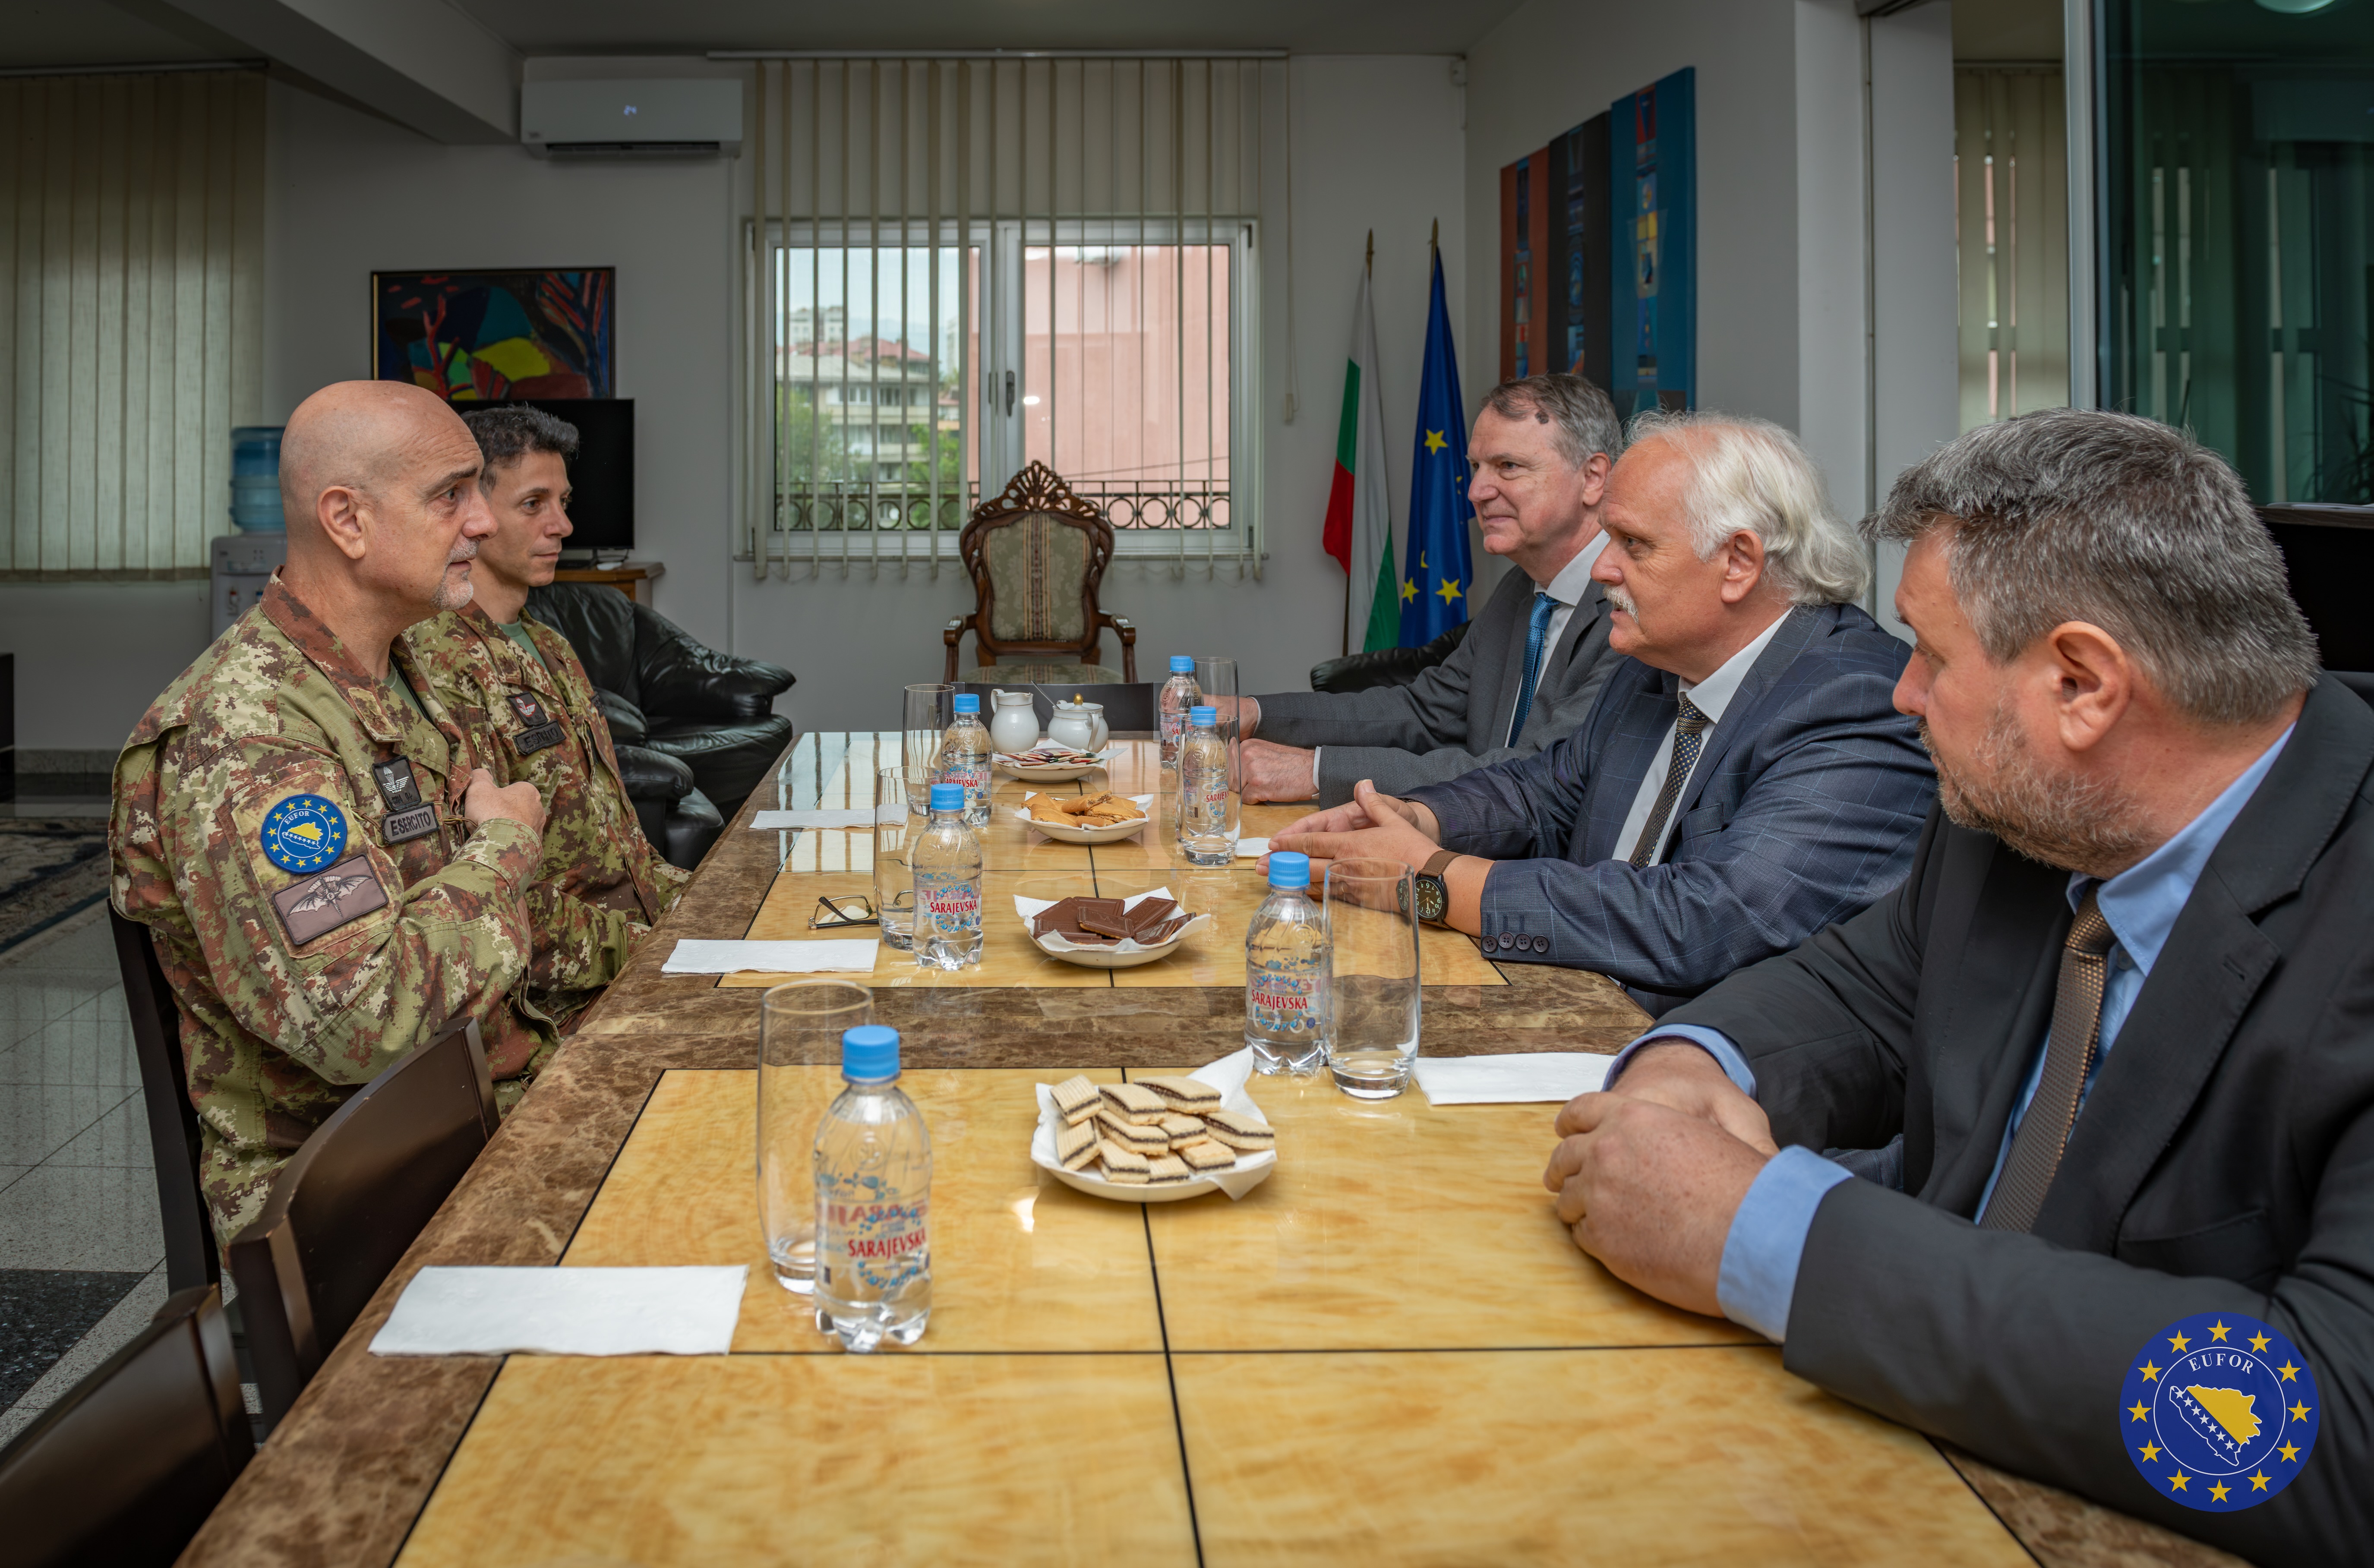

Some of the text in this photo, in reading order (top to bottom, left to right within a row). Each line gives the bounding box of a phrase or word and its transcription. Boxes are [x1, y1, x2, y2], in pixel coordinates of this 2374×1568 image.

[284, 811, 309, 825] EUFOR
[390, 811, 431, 836] ESERCITO
[930, 899, 977, 916] SARAJEVSKA
[1252, 989, 1308, 1011] SARAJEVSKA
